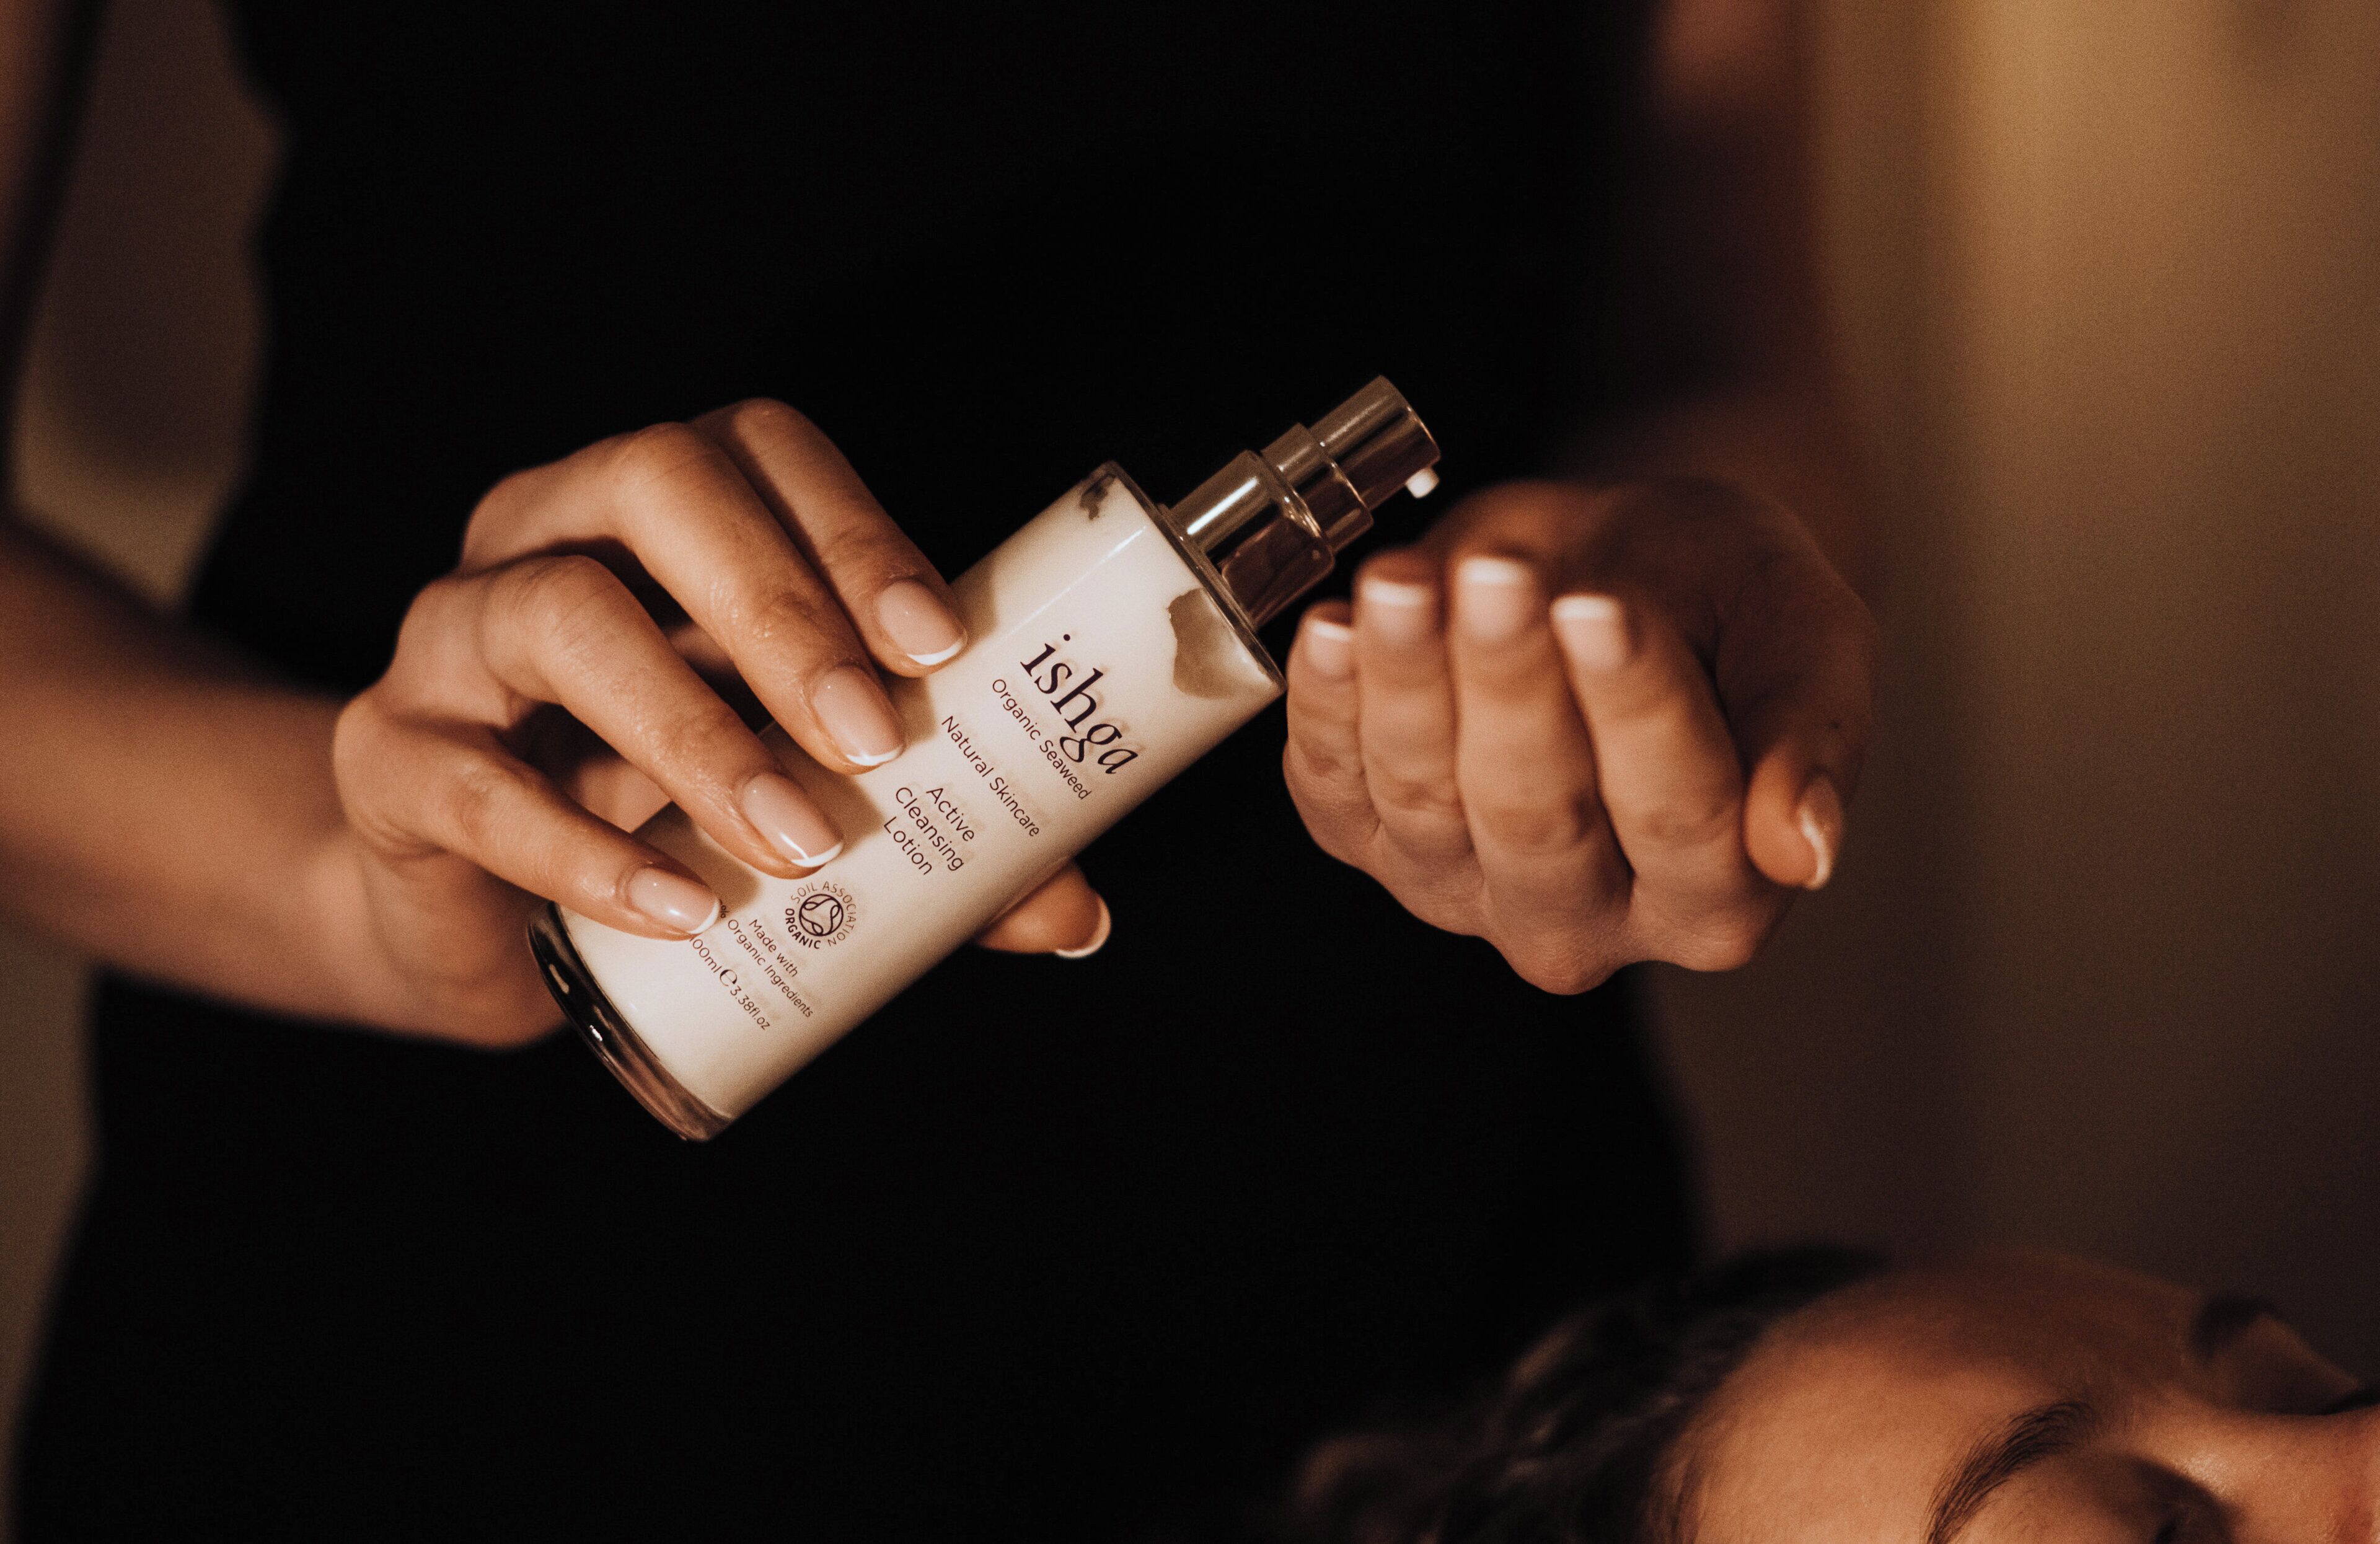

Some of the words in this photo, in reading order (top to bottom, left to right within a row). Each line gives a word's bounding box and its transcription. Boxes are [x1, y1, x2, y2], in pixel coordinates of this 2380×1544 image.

[992, 679, 1041, 740] Organic
[1039, 740, 1092, 800] Seaweed
[1020, 634, 1138, 774] ishga
[941, 715, 994, 777] Natural
[990, 777, 1039, 837] Skincare
[884, 816, 932, 875] Lotion
[896, 787, 964, 871] Cleansing
[926, 788, 974, 841] Active
[749, 919, 777, 953] Made
[777, 953, 798, 977] with
[785, 908, 821, 949] ORGANIC
[791, 882, 818, 904] SOIL
[822, 881, 856, 946] ASSOCIATION
[728, 919, 766, 966] Organic
[764, 965, 813, 1018] Ingredients
